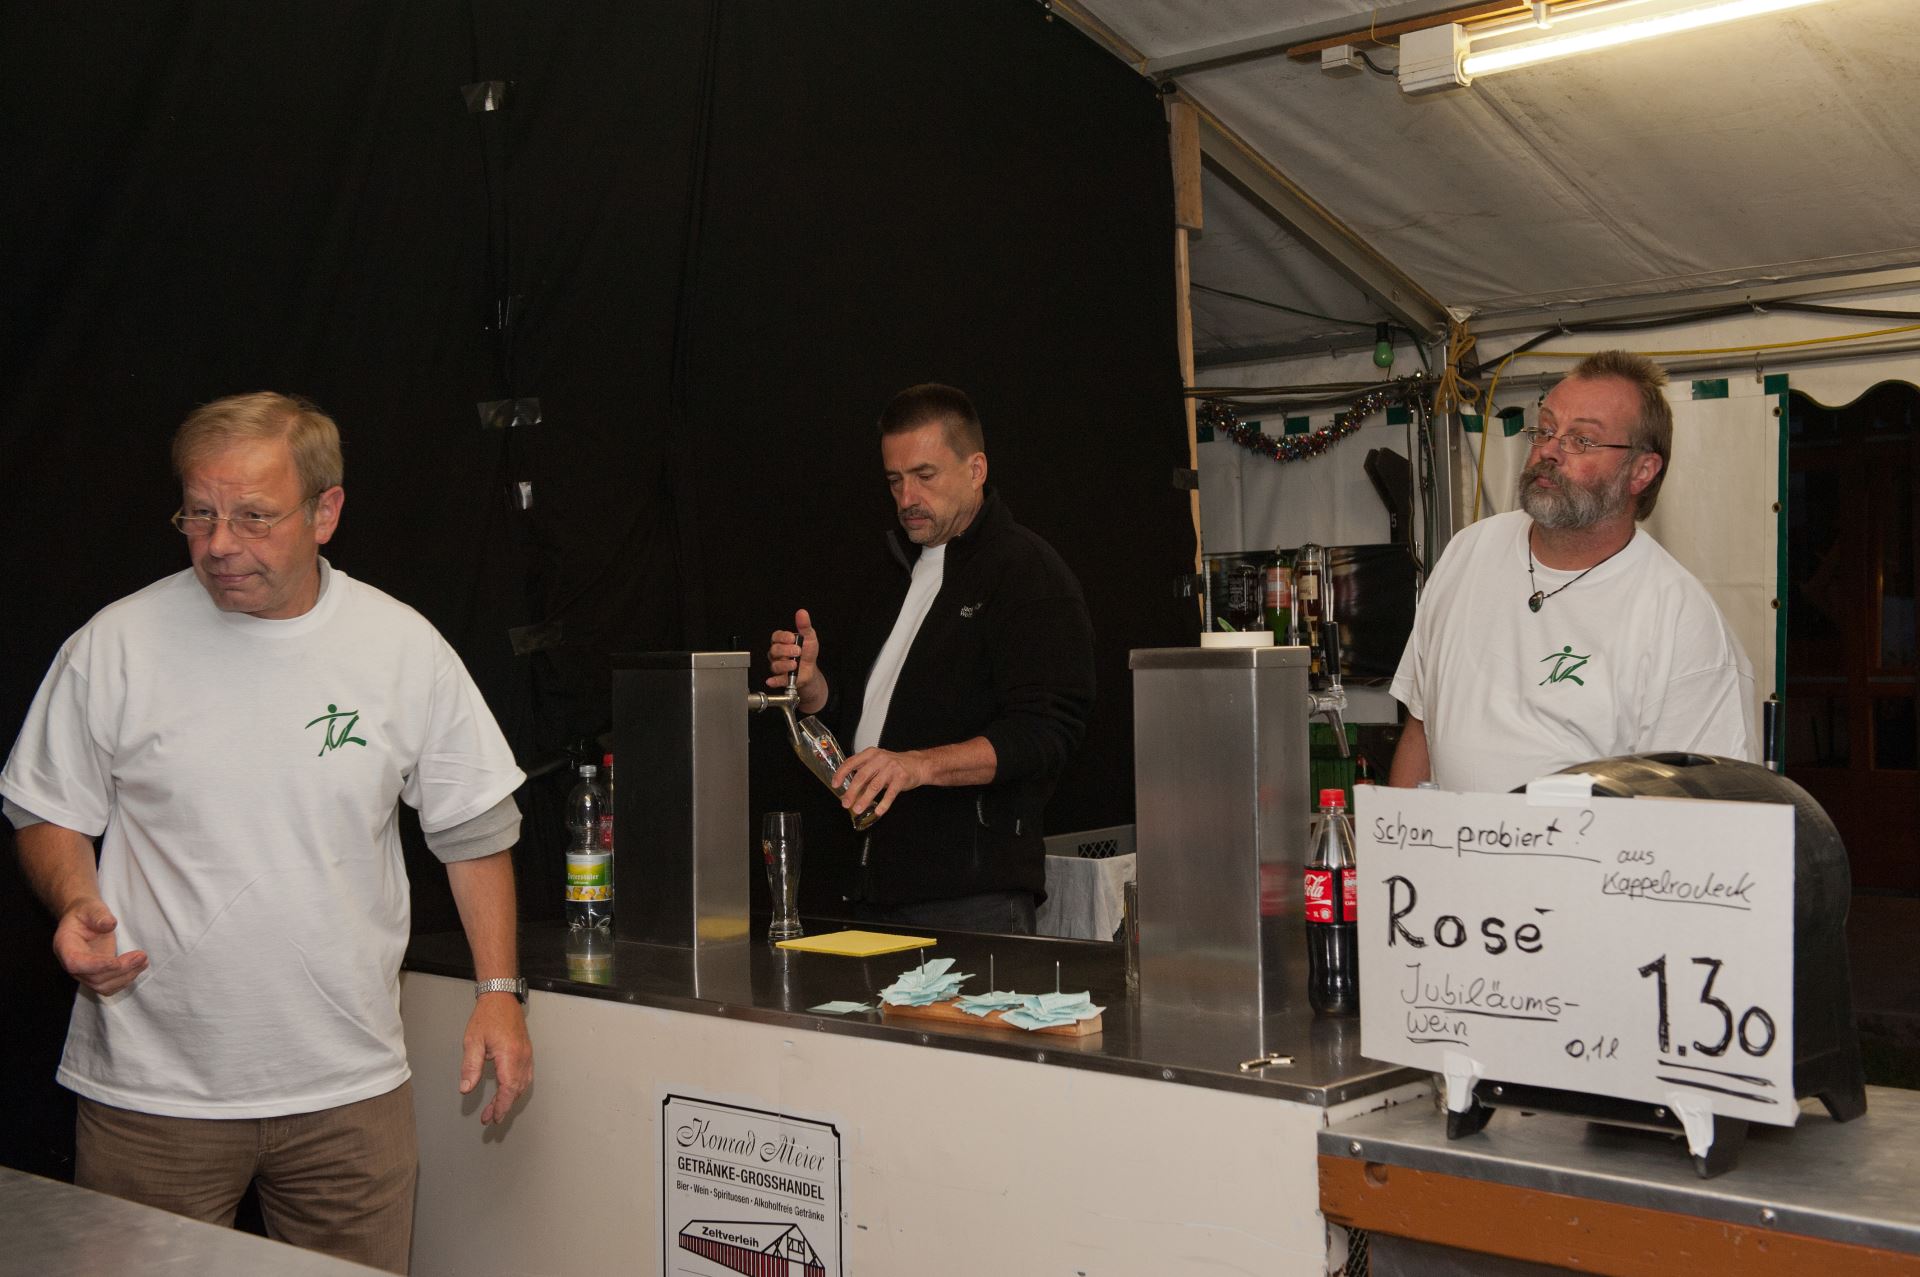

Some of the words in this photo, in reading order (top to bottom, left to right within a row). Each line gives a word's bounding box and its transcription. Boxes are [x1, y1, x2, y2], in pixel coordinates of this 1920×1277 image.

[1617, 850, 1655, 865] aus
[1382, 875, 1554, 955] Rosé
[1401, 963, 1580, 1015] Jubiläums-
[1638, 954, 1776, 1057] 1.30
[676, 1118, 756, 1157] Konrad
[759, 1135, 825, 1171] Meier
[676, 1180, 689, 1191] Bier
[693, 1184, 709, 1196] Wein
[713, 1188, 750, 1204] Spirituosen
[754, 1197, 793, 1215] Alkoholfreie
[794, 1206, 825, 1222] Getränke
[677, 1156, 825, 1200] GETRÄNKE-GROSSHANDEL
[702, 1226, 759, 1248] Zeltverleih
